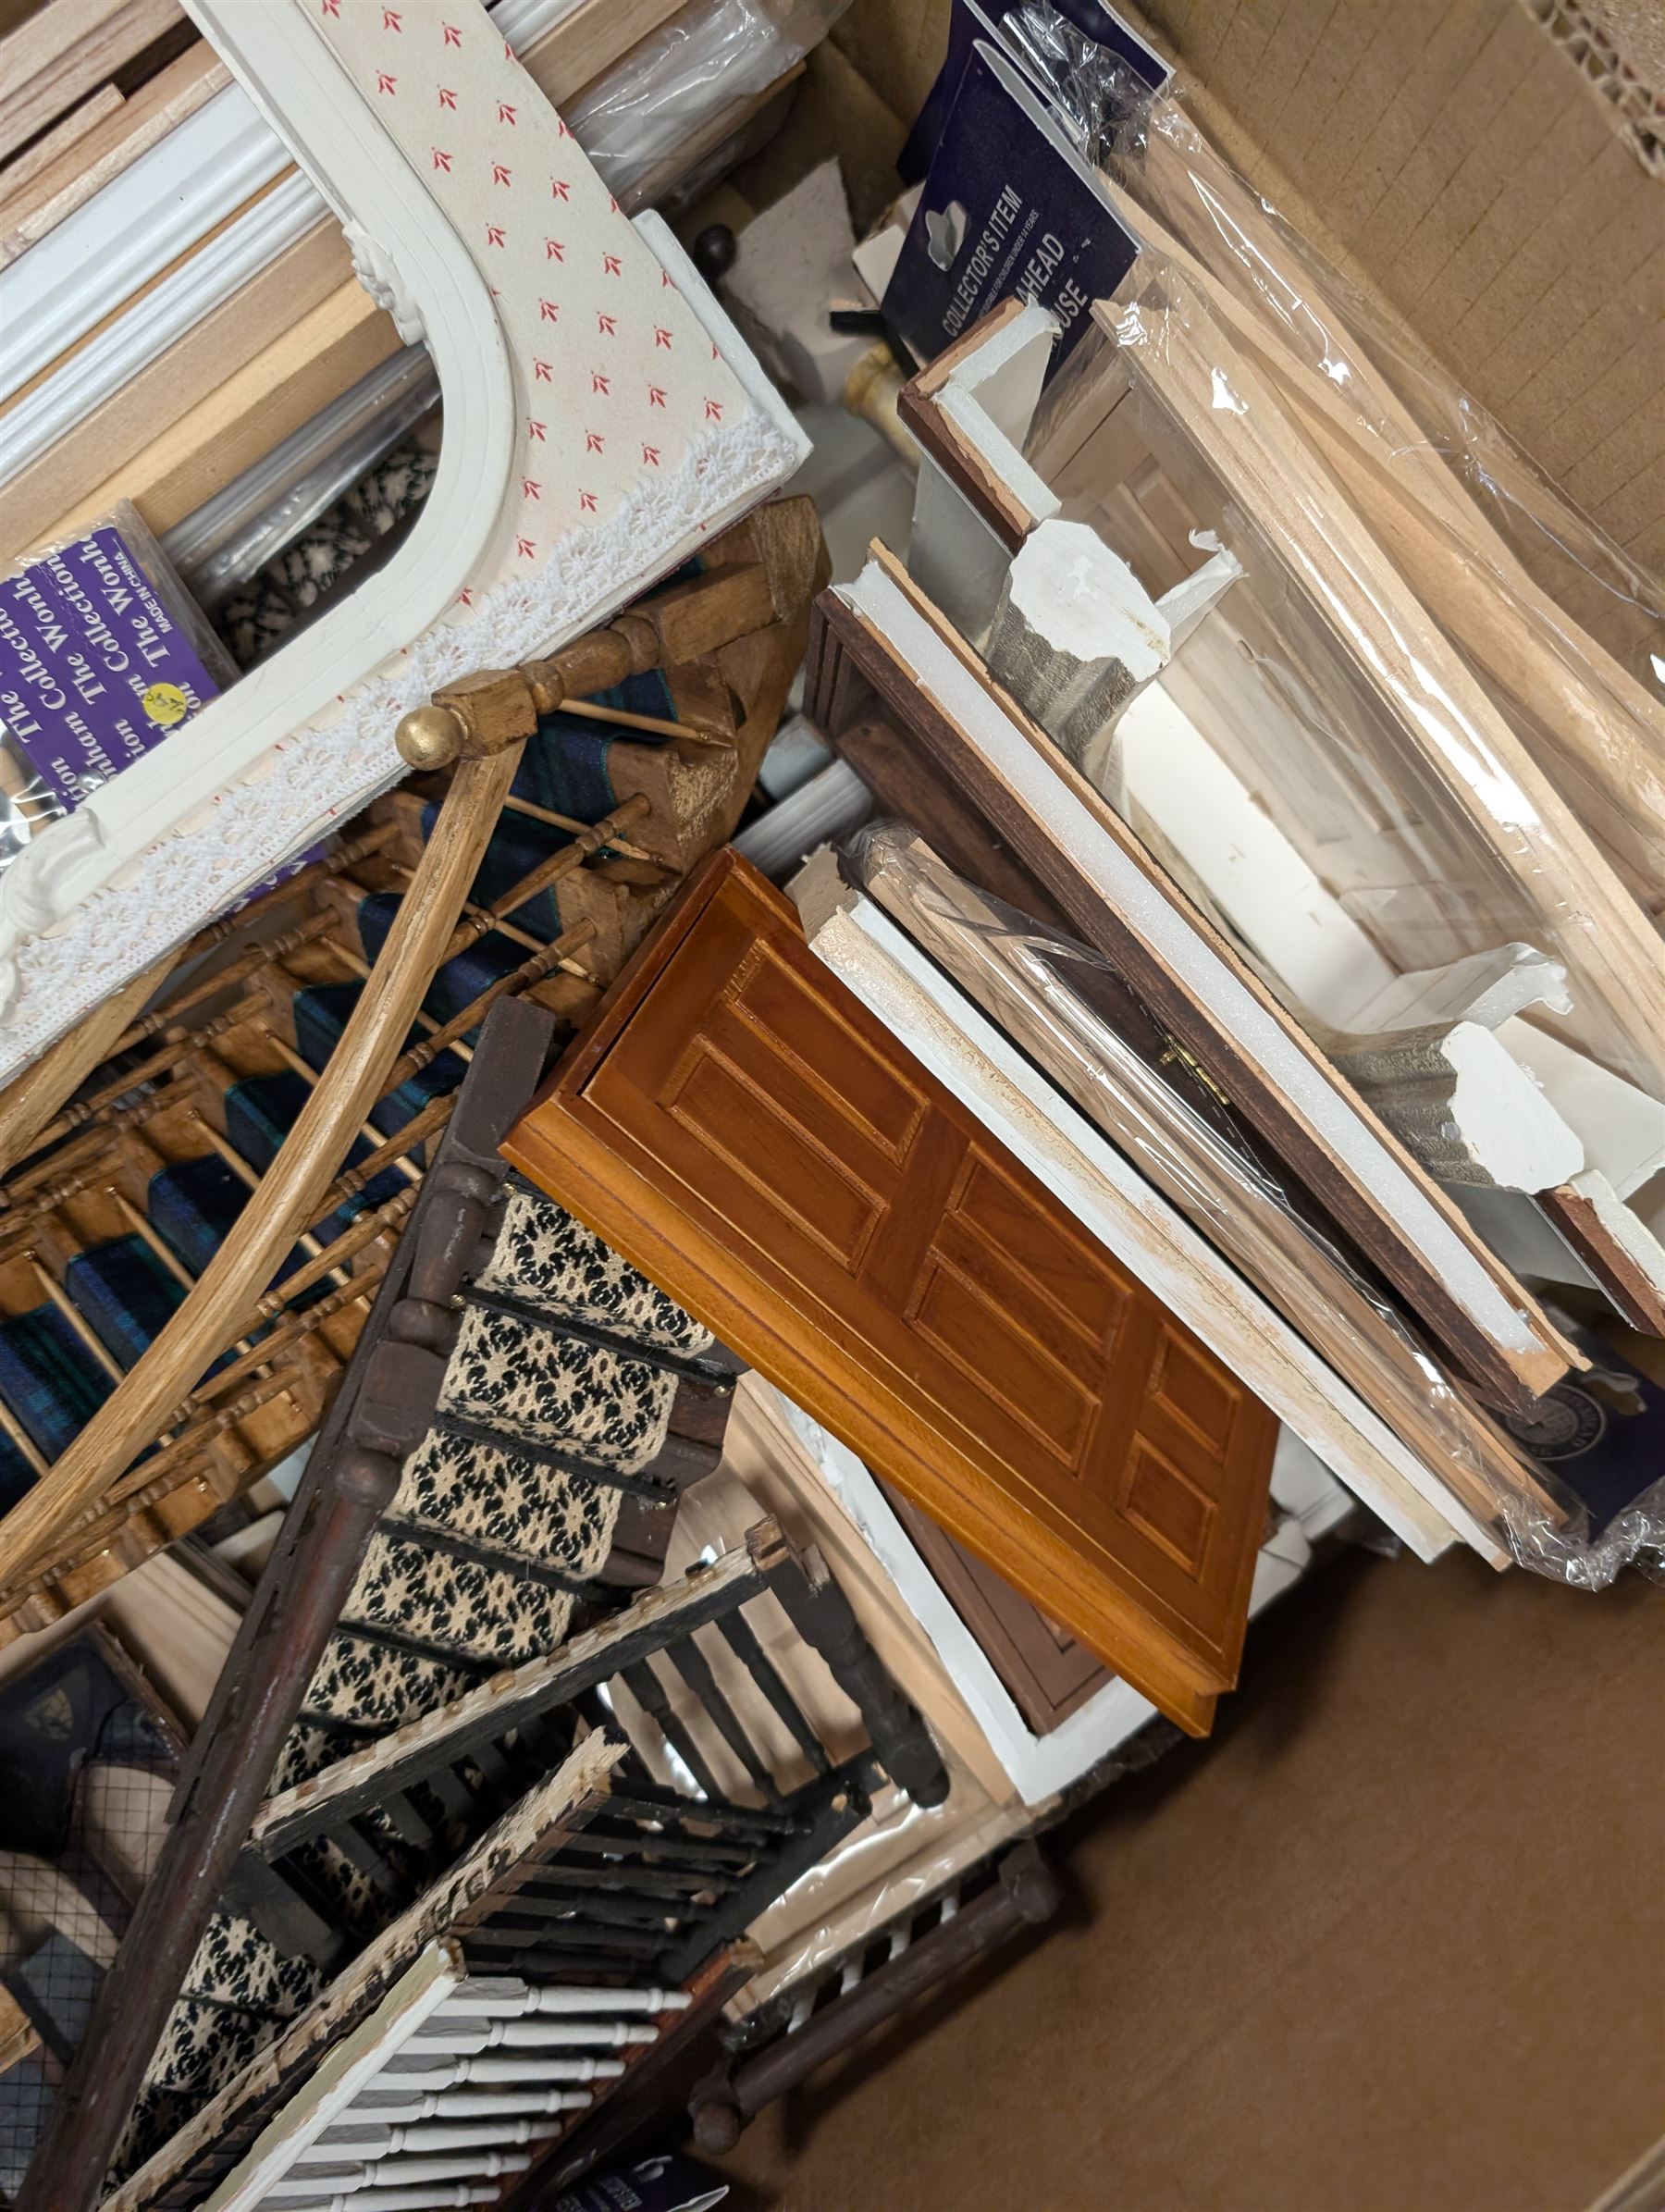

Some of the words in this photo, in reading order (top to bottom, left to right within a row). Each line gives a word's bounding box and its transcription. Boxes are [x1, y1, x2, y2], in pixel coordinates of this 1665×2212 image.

[942, 230, 1000, 337] COLLECTOR'S
[988, 184, 1022, 241] ITEM
[997, 253, 1016, 280] CHILDREN
[1008, 235, 1025, 258] UNDER
[1016, 233, 1065, 308] AHEAD
[1051, 278, 1088, 348] USE
[78, 534, 134, 616] Wonh
[114, 551, 142, 587] CHINA
[135, 586, 152, 601] IN
[9, 570, 68, 654] Wonh
[46, 554, 130, 673] Collection
[131, 616, 170, 669] The
[144, 599, 173, 634] MADE
[72, 652, 107, 705] The
[1, 690, 43, 743] The
[65, 711, 119, 783] nham
